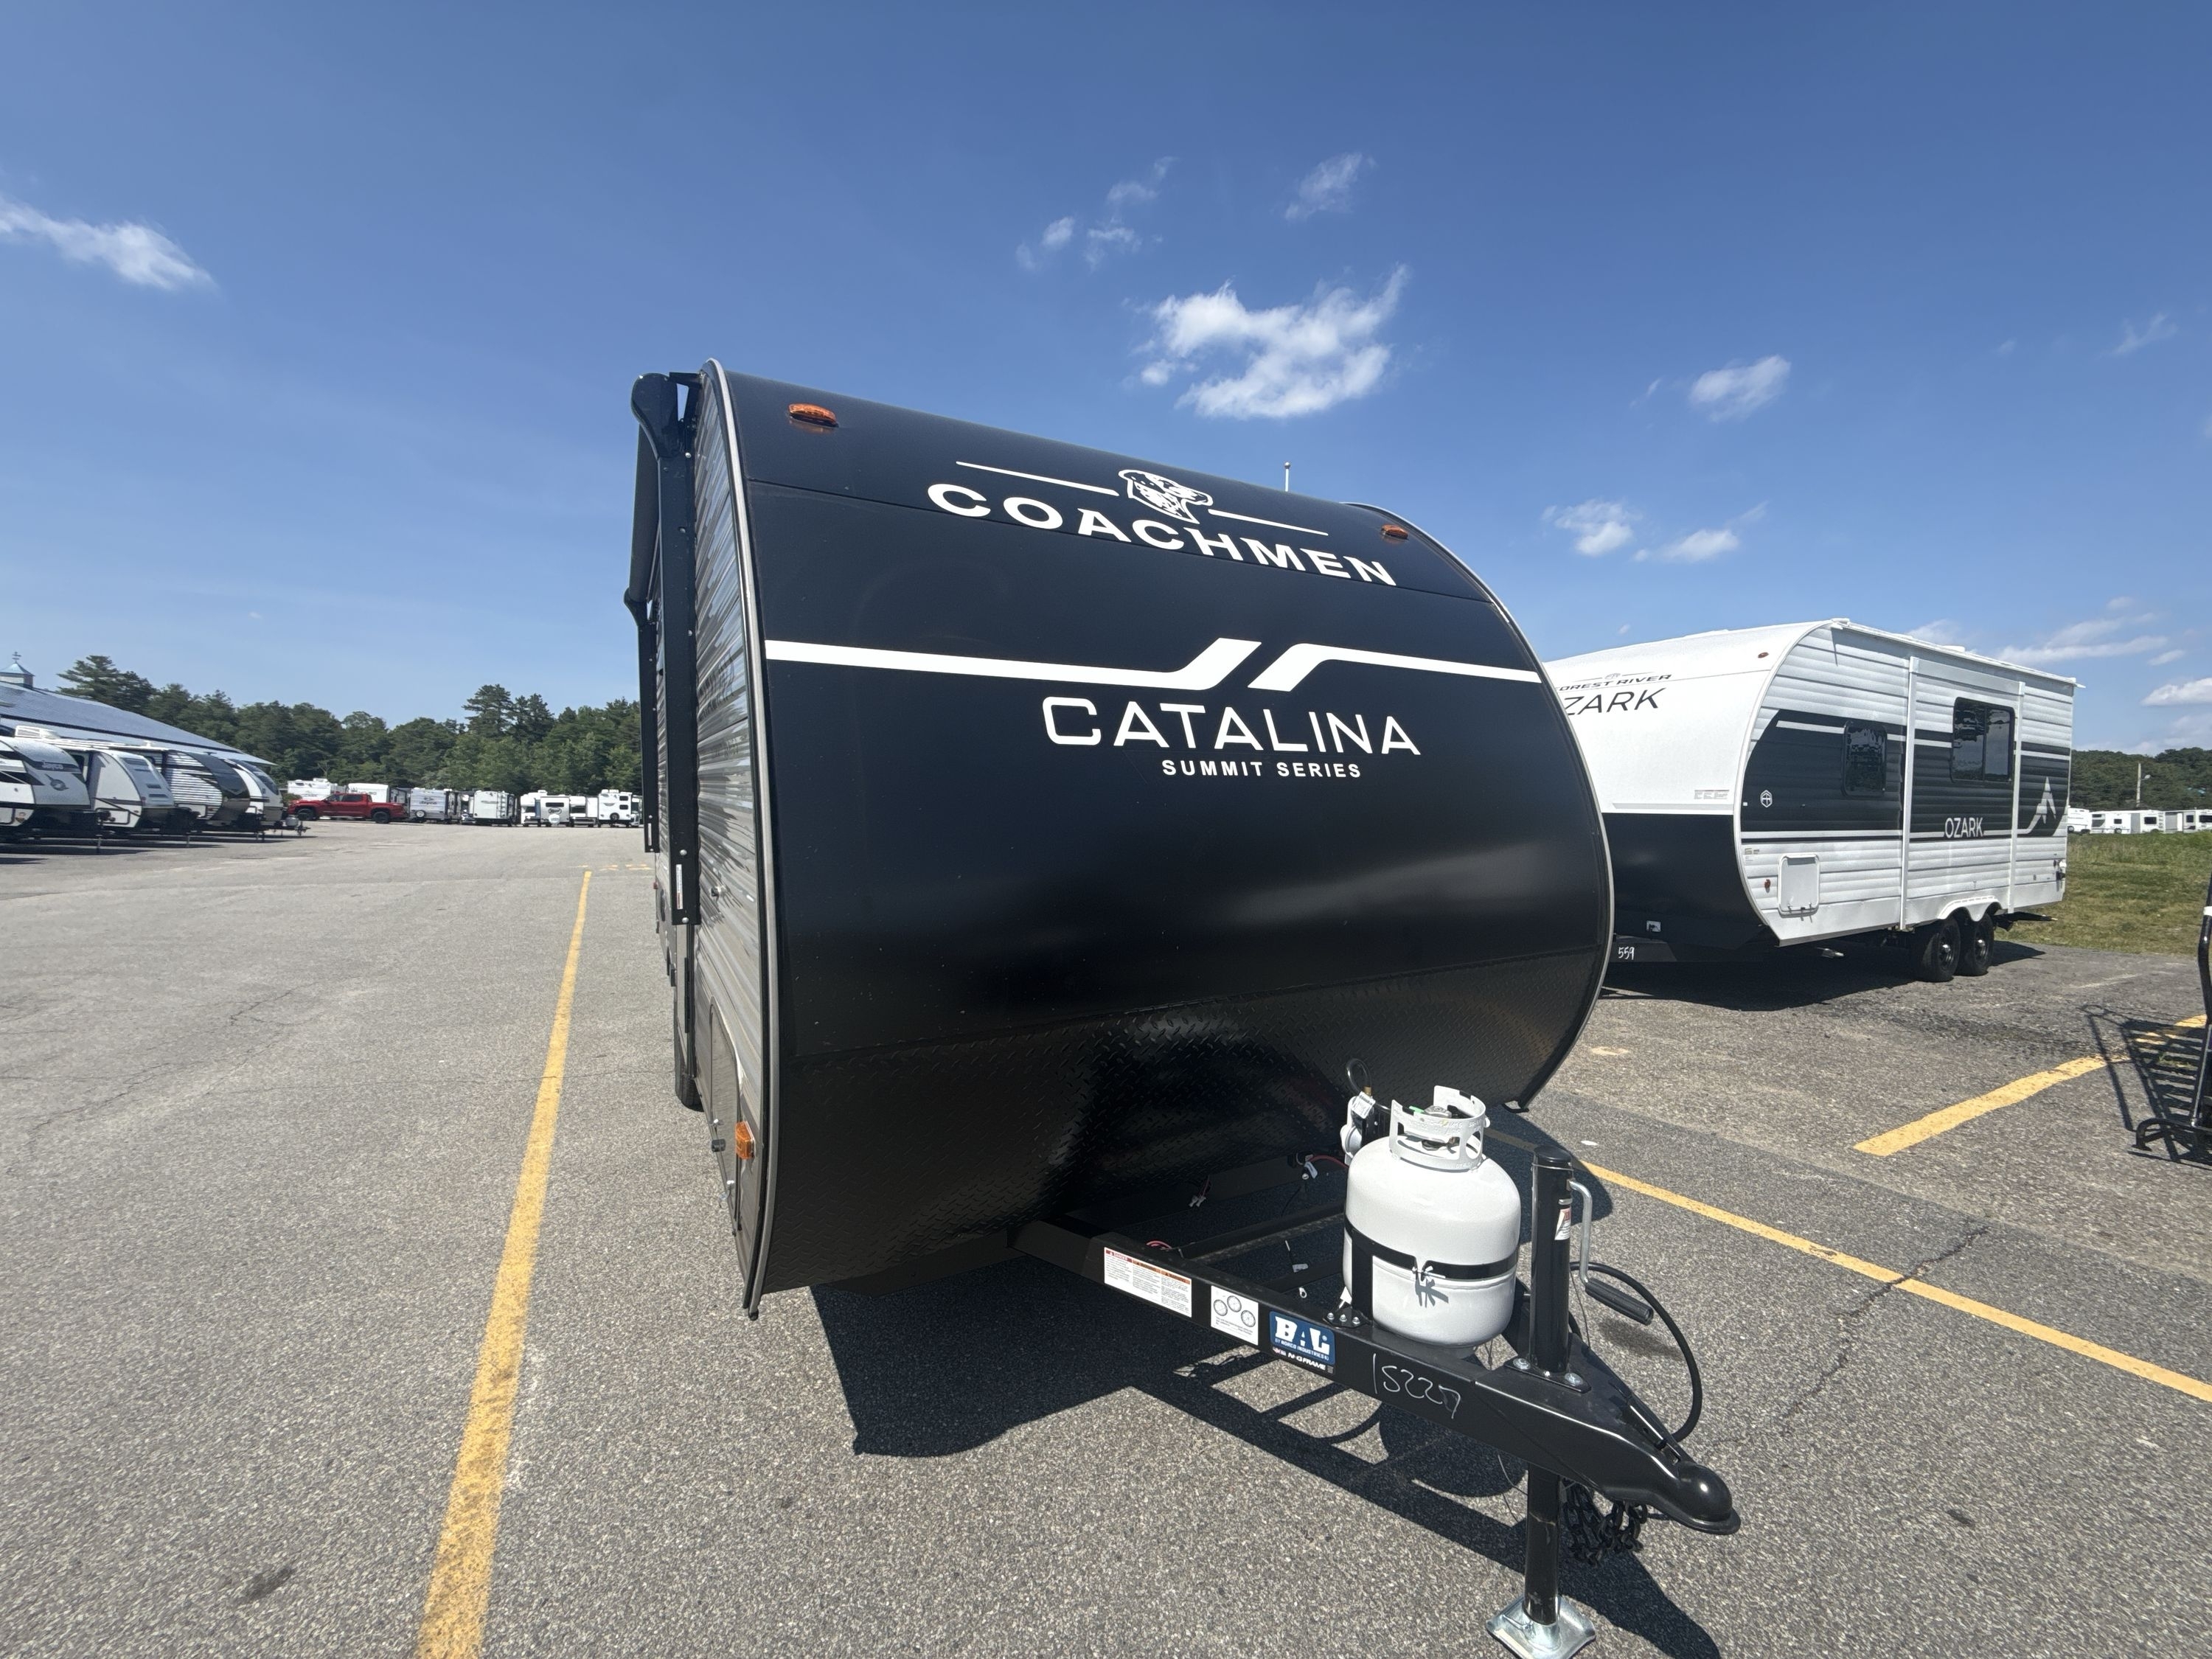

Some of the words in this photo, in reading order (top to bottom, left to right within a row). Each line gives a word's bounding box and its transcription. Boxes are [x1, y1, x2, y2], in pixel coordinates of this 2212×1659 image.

[928, 483, 1397, 586] COACHMEN
[1616, 674, 1672, 685] RIVER
[1042, 696, 1421, 756] CATALINA
[1161, 759, 1262, 776] SUMMIT
[1277, 762, 1360, 778] SERIES
[1944, 817, 1983, 838] OZARK
[1618, 946, 1635, 961] 559
[1275, 1316, 1330, 1355] BAL
[1297, 1346, 1324, 1360] INDUSTRIES
[1303, 1357, 1326, 1371] FRAME
